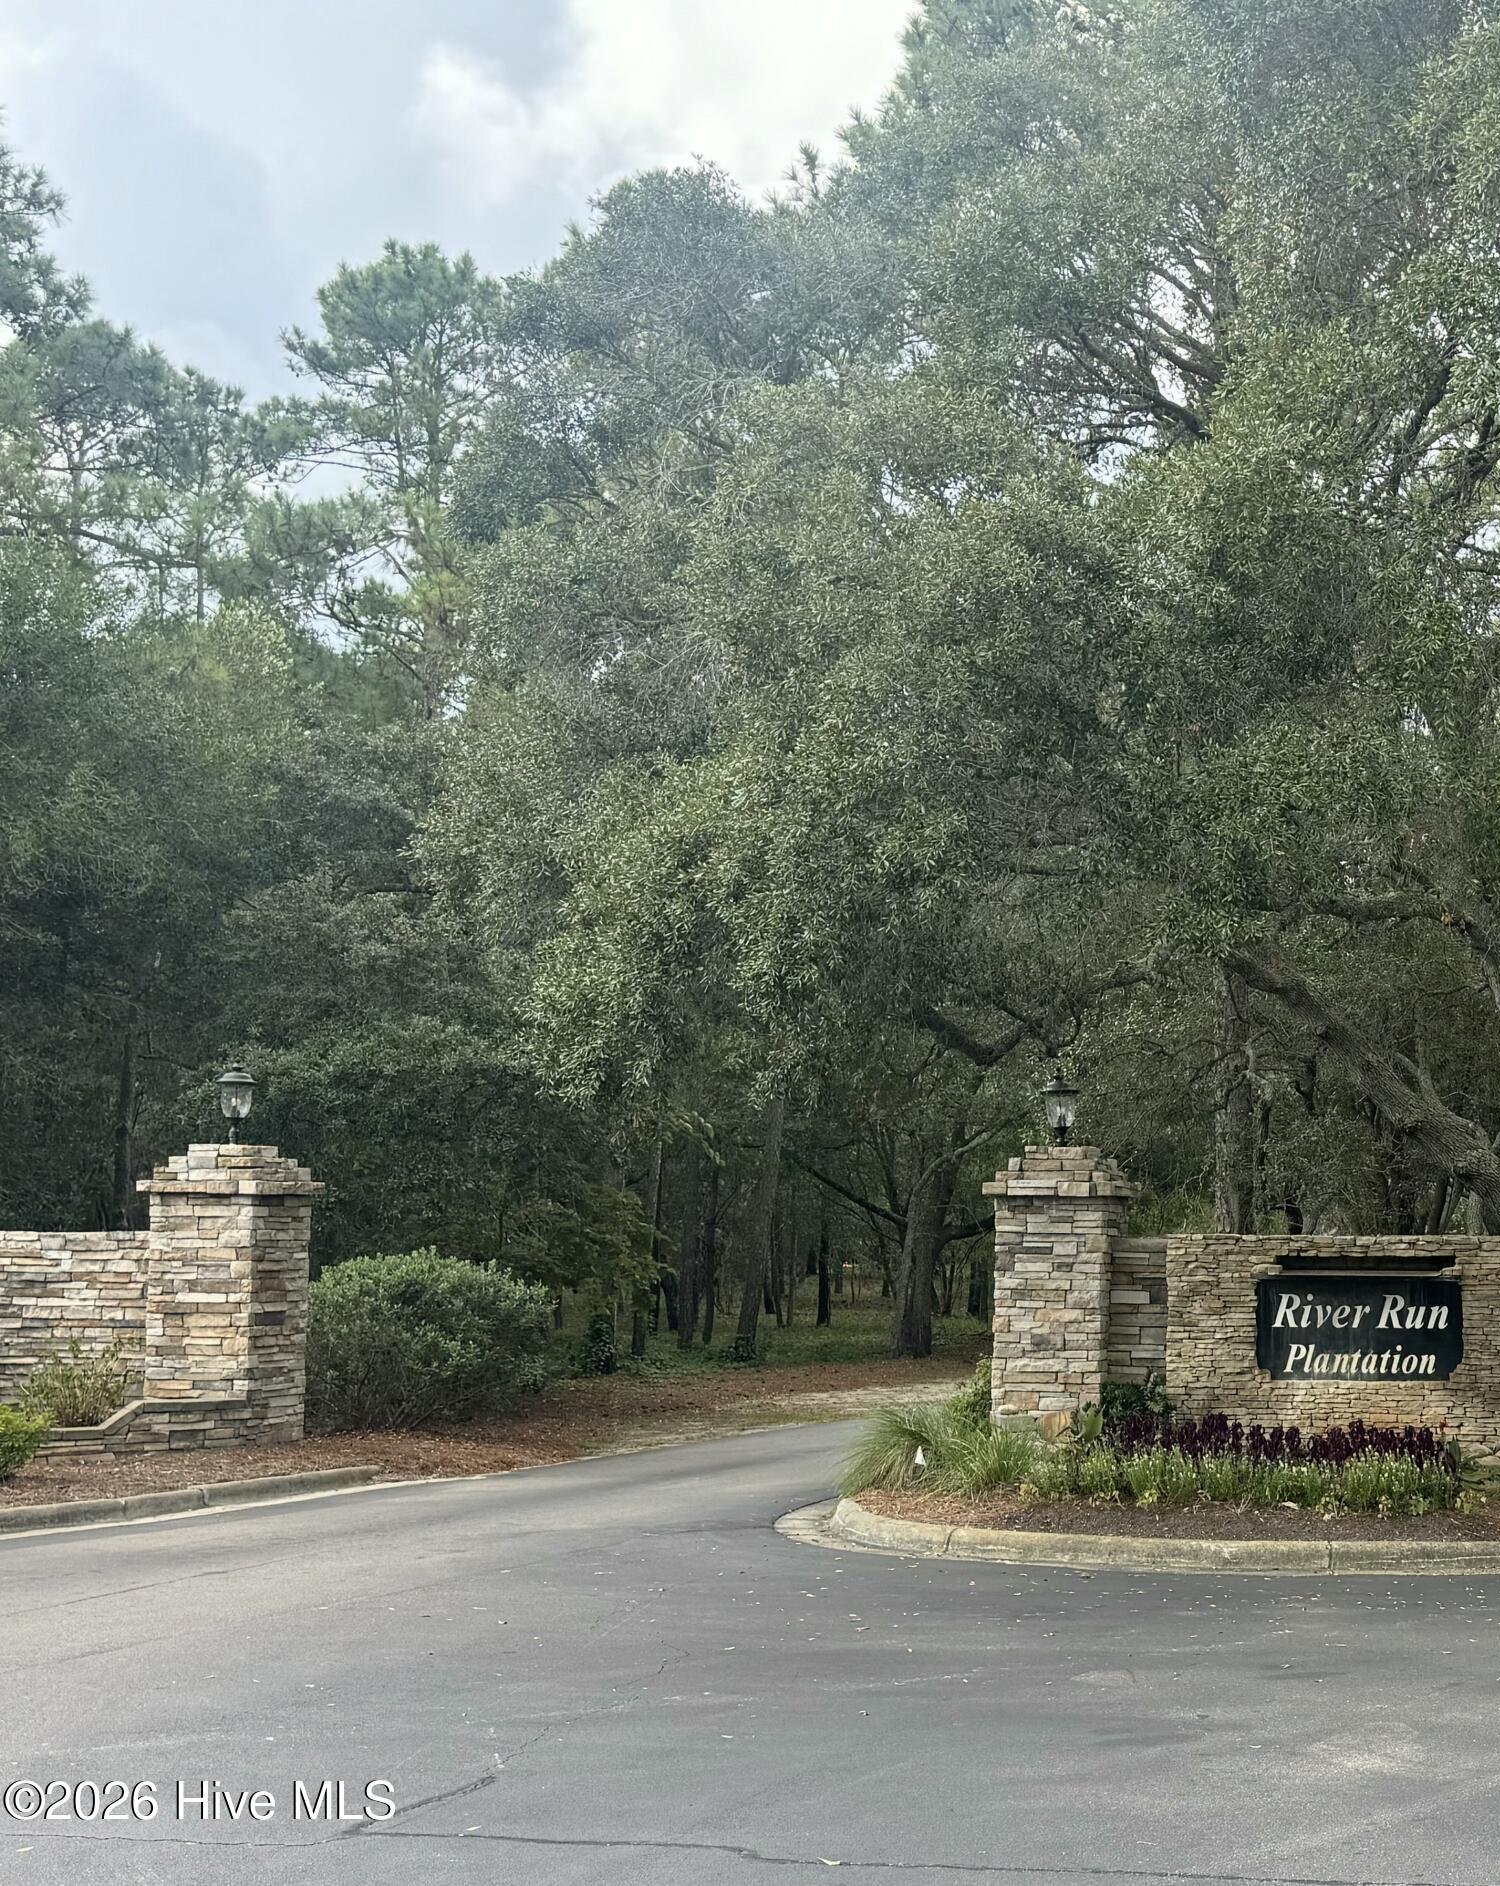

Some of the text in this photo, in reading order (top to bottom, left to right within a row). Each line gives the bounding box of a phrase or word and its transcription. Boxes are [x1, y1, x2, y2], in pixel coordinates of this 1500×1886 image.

[1272, 1294, 1449, 1329] River Run
[1283, 1344, 1436, 1375] Plantation
